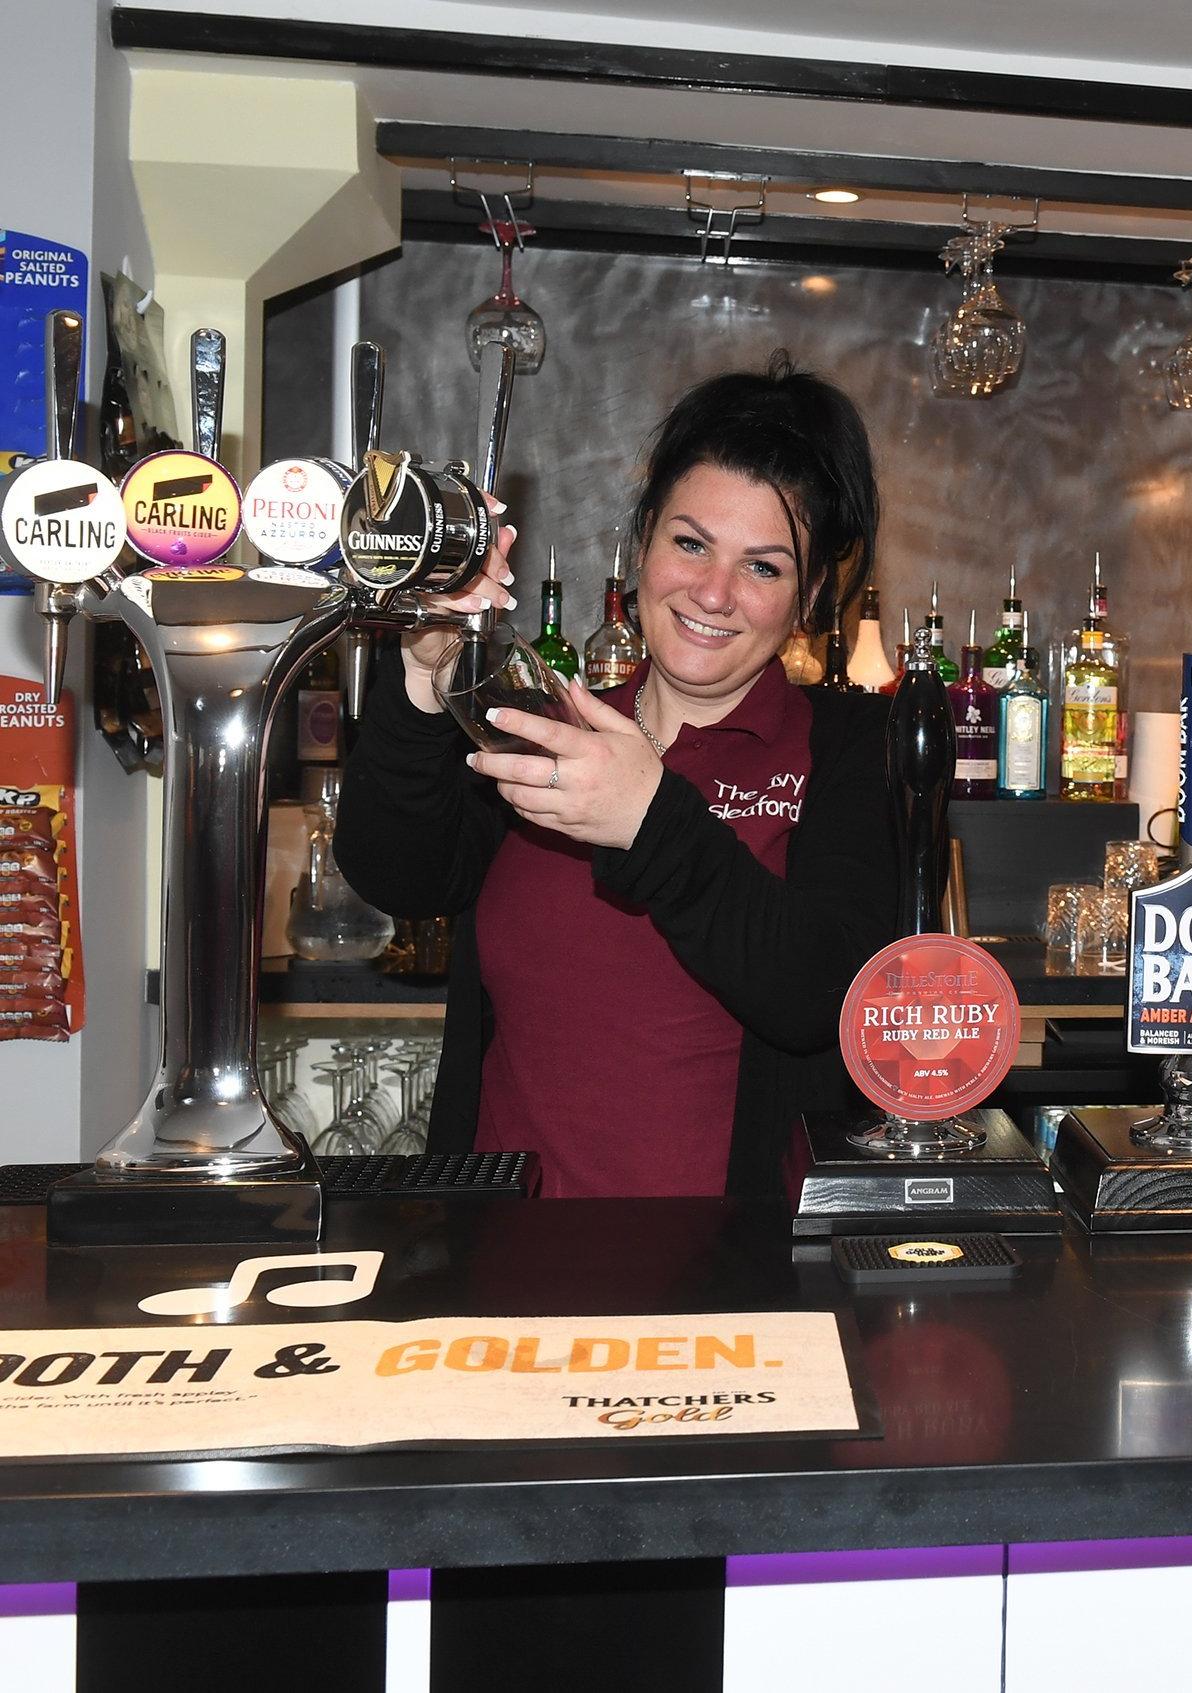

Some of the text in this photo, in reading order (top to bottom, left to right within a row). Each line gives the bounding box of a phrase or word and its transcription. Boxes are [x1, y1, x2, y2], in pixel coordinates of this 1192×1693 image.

[12, 250, 74, 262] ORIGINAL
[20, 261, 65, 273] SALTED
[5, 272, 79, 287] PEANUTS
[135, 500, 226, 530] CARLING
[253, 498, 336, 520] PERONI
[16, 518, 115, 548] CARLING
[261, 530, 326, 539] AZZURRO
[430, 502, 443, 553] GUINNESS
[475, 506, 487, 556] GUINNESS
[348, 531, 424, 551] GUINNESS
[15, 693, 40, 703] DRY
[0, 714, 65, 728] EANUTS
[713, 779, 758, 801] The
[708, 795, 803, 823] Sleaford
[863, 1003, 999, 1027] RICH RUBY
[1140, 1008, 1187, 1024] AMBER
[882, 1028, 980, 1042] RUBY RED ALE
[1147, 1037, 1180, 1045] MOREISH
[914, 1069, 949, 1078] ABV 4.5%
[910, 1187, 949, 1196] ANGRAM
[254, 1343, 341, 1379] &
[374, 1334, 784, 1377] GOLDEN.
[561, 1392, 777, 1408] THATCHERS
[597, 1406, 734, 1431] Gold
